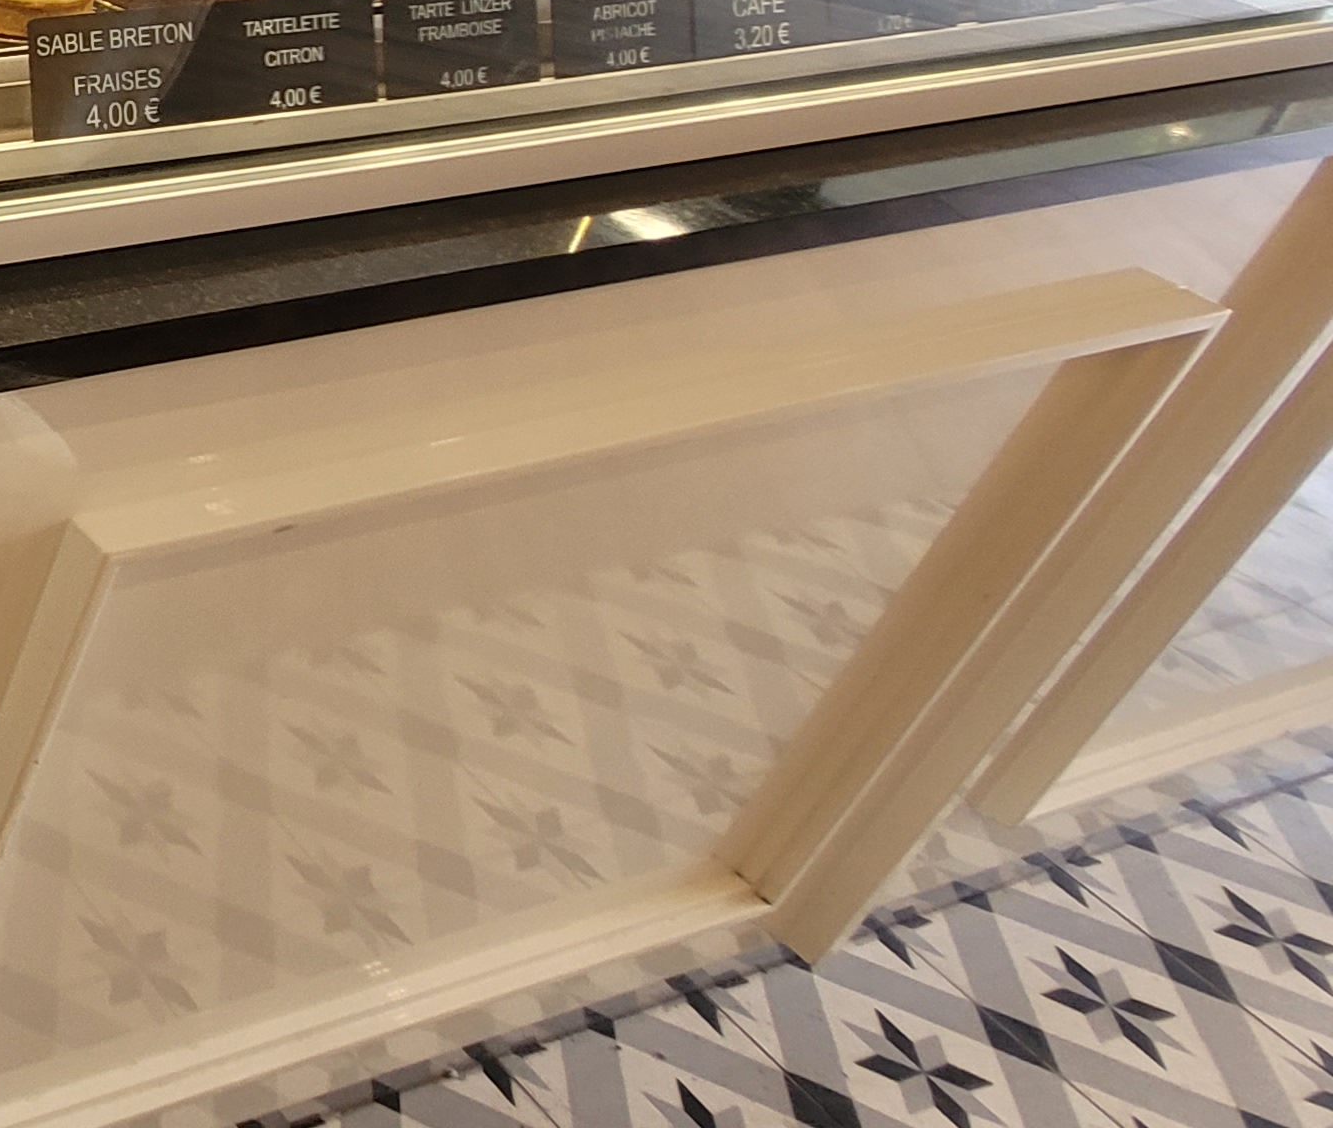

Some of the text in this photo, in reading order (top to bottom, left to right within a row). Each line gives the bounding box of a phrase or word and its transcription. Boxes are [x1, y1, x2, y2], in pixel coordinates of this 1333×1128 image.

[409, 1, 455, 20] TARTE
[593, 0, 657, 21] ABRICOT
[243, 13, 341, 37] TARTELETTE
[418, 19, 502, 42] FRAMBOISE
[590, 22, 656, 42] PISTACHE
[734, 21, 791, 51] 3,20 €
[36, 21, 194, 58] SABLE BRETON
[264, 46, 325, 67] CITRON
[639, 46, 651, 63] €
[73, 68, 163, 96] FRAISES
[476, 67, 489, 84] €
[269, 85, 323, 110] 4,00 €
[86, 97, 162, 130] 4,00 €
